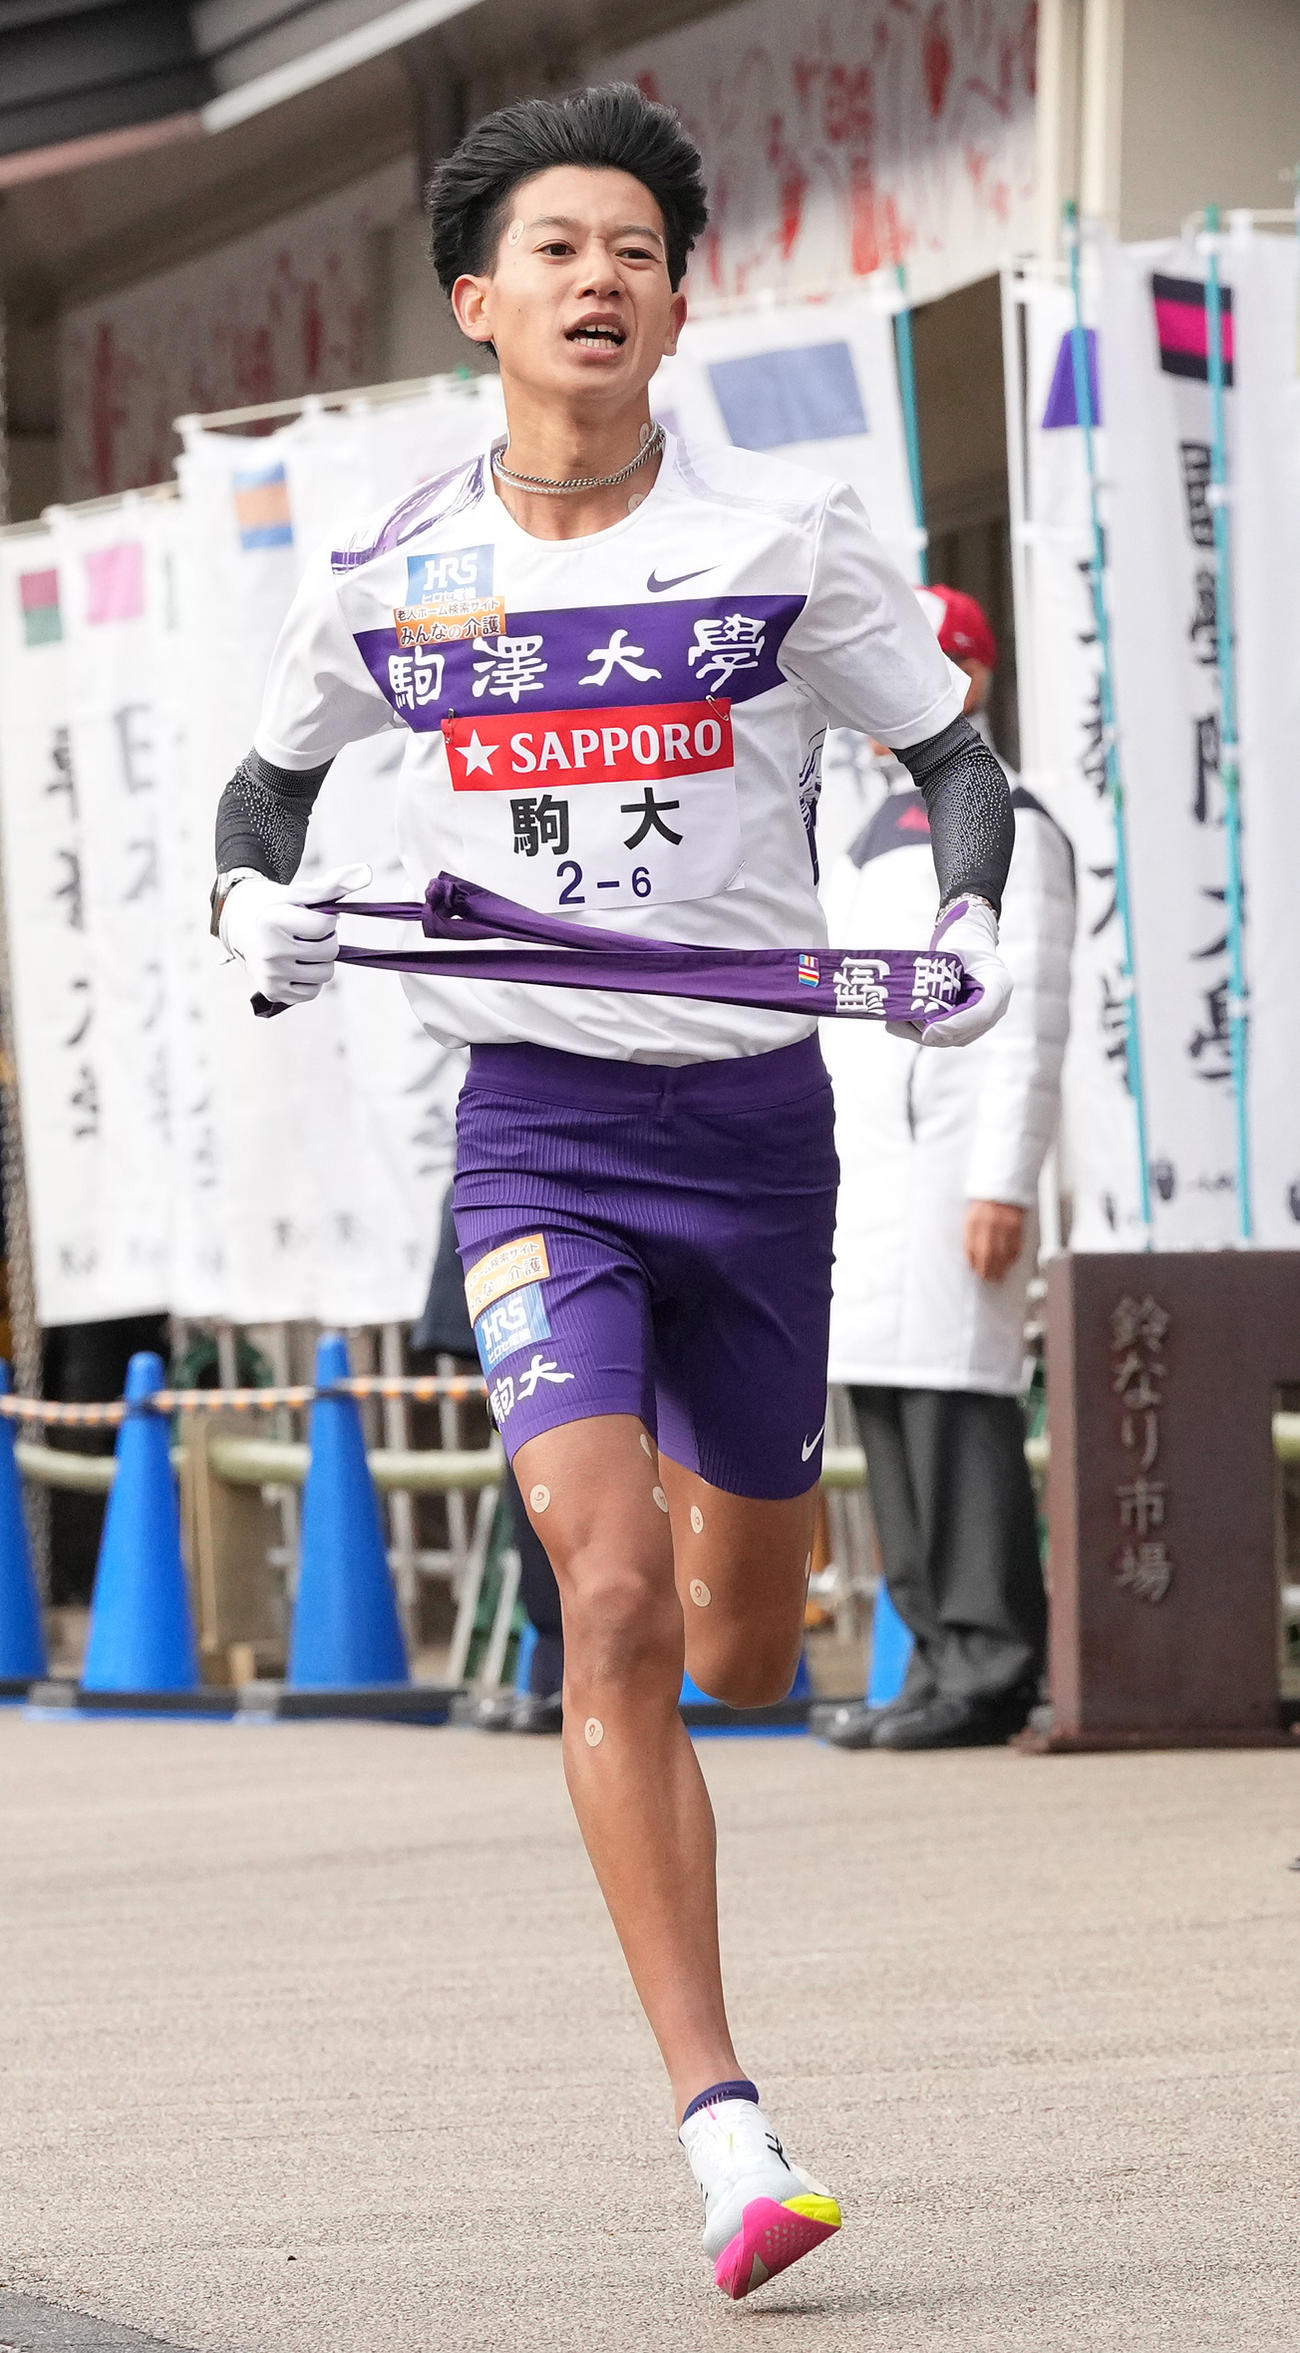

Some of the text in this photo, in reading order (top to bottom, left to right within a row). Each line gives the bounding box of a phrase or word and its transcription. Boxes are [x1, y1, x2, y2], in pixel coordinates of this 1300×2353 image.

[424, 552, 478, 591] HRS
[396, 599, 500, 622] 老人ホーム検索サイト
[400, 615, 500, 646] みんなの介護
[509, 718, 723, 774] SAPPORO
[481, 1296, 527, 1351] HRS
[1109, 1295, 1174, 1602] 鈴なり市場
